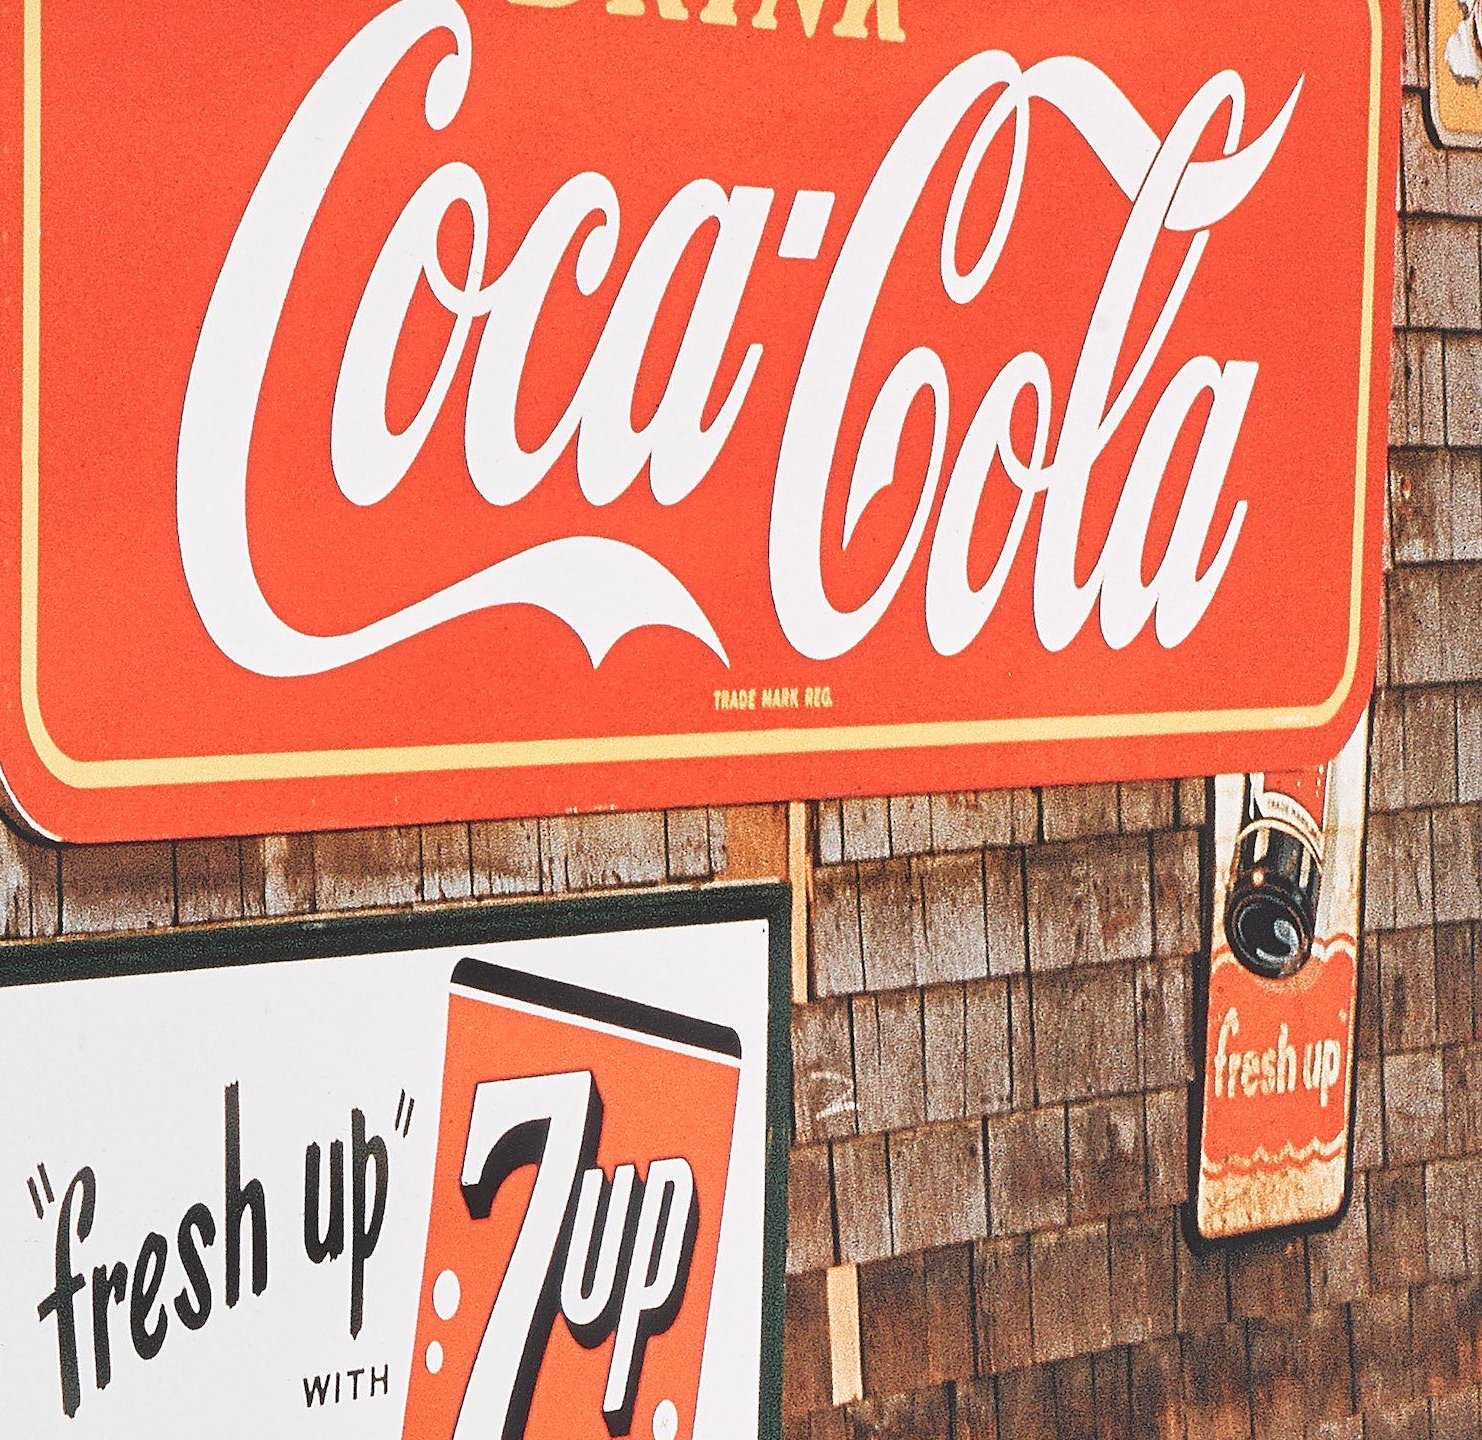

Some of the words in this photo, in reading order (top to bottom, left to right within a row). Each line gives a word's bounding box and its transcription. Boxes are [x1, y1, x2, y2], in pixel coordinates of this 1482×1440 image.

[175, 0, 1305, 677] Coca-Cola
[712, 688, 756, 711] TRADE
[761, 686, 800, 709] MARK
[27, 1080, 269, 1419] "fresh
[302, 1087, 416, 1340] up"
[302, 1363, 391, 1409] WITH
